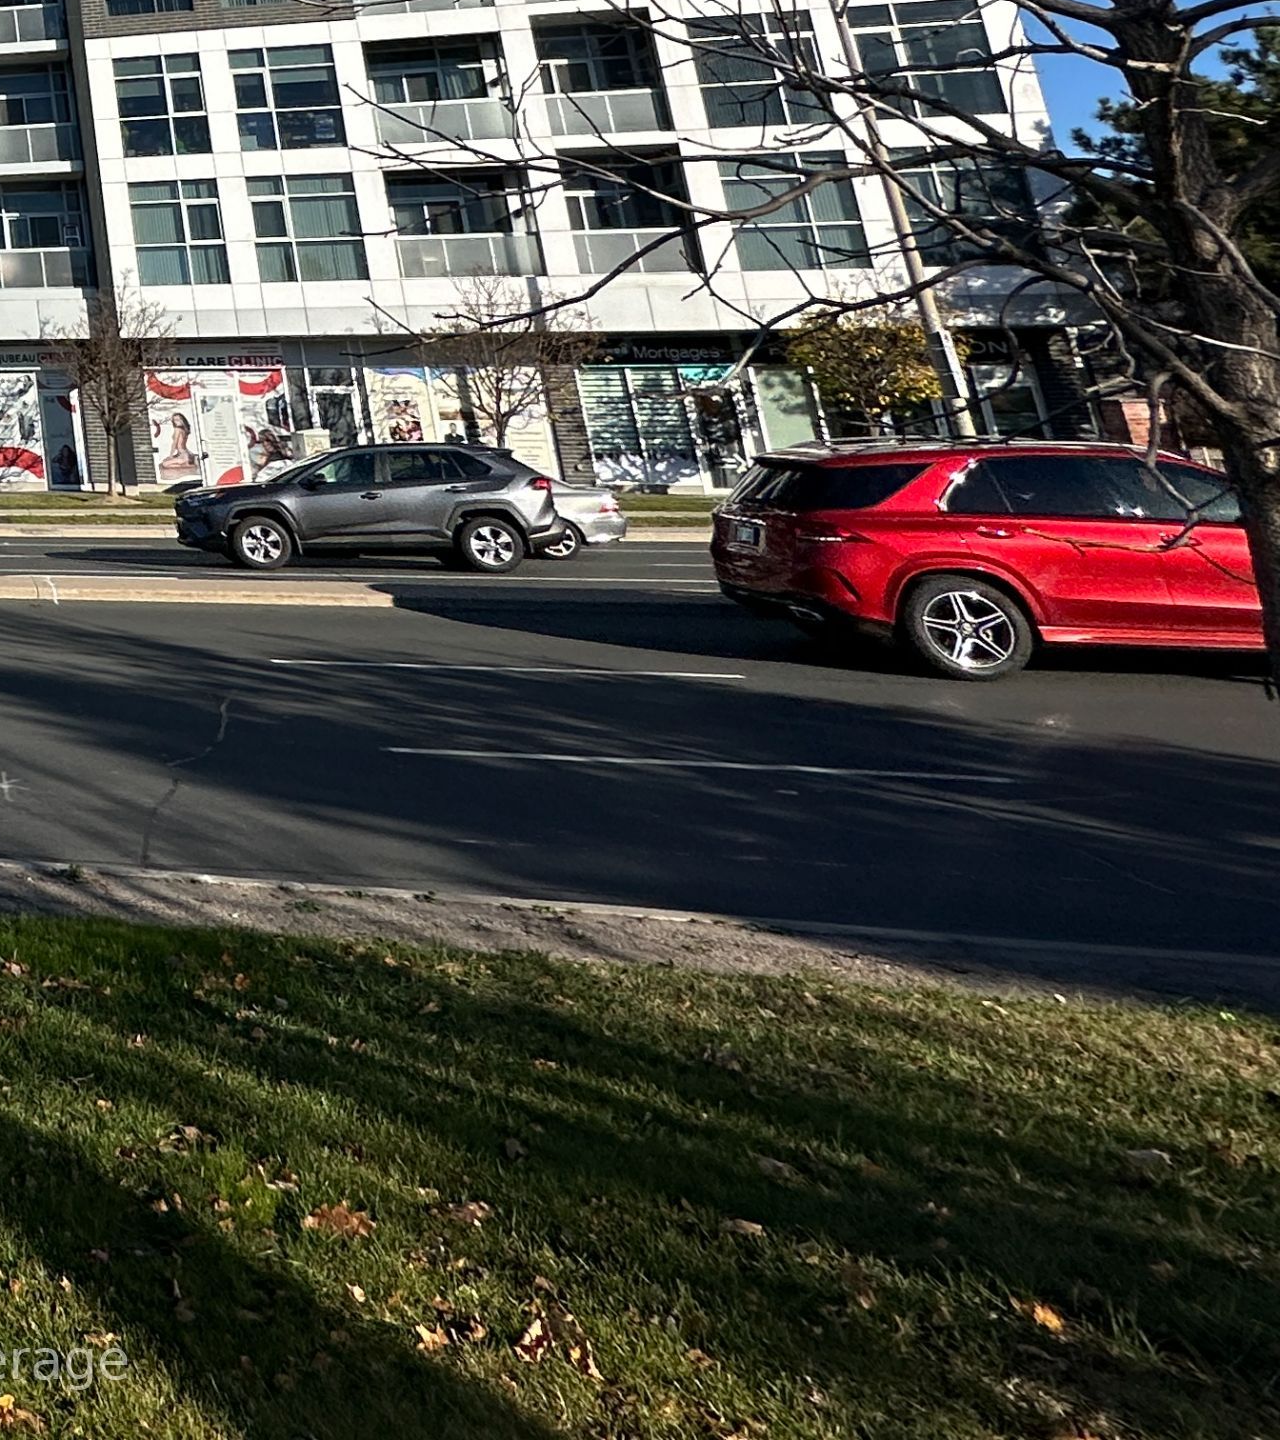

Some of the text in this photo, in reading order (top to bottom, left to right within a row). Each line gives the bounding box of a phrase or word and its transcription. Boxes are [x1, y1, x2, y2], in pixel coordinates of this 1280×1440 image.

[633, 346, 721, 361] Mortgages
[185, 357, 227, 366] CARE
[230, 356, 283, 366] CLINIC
